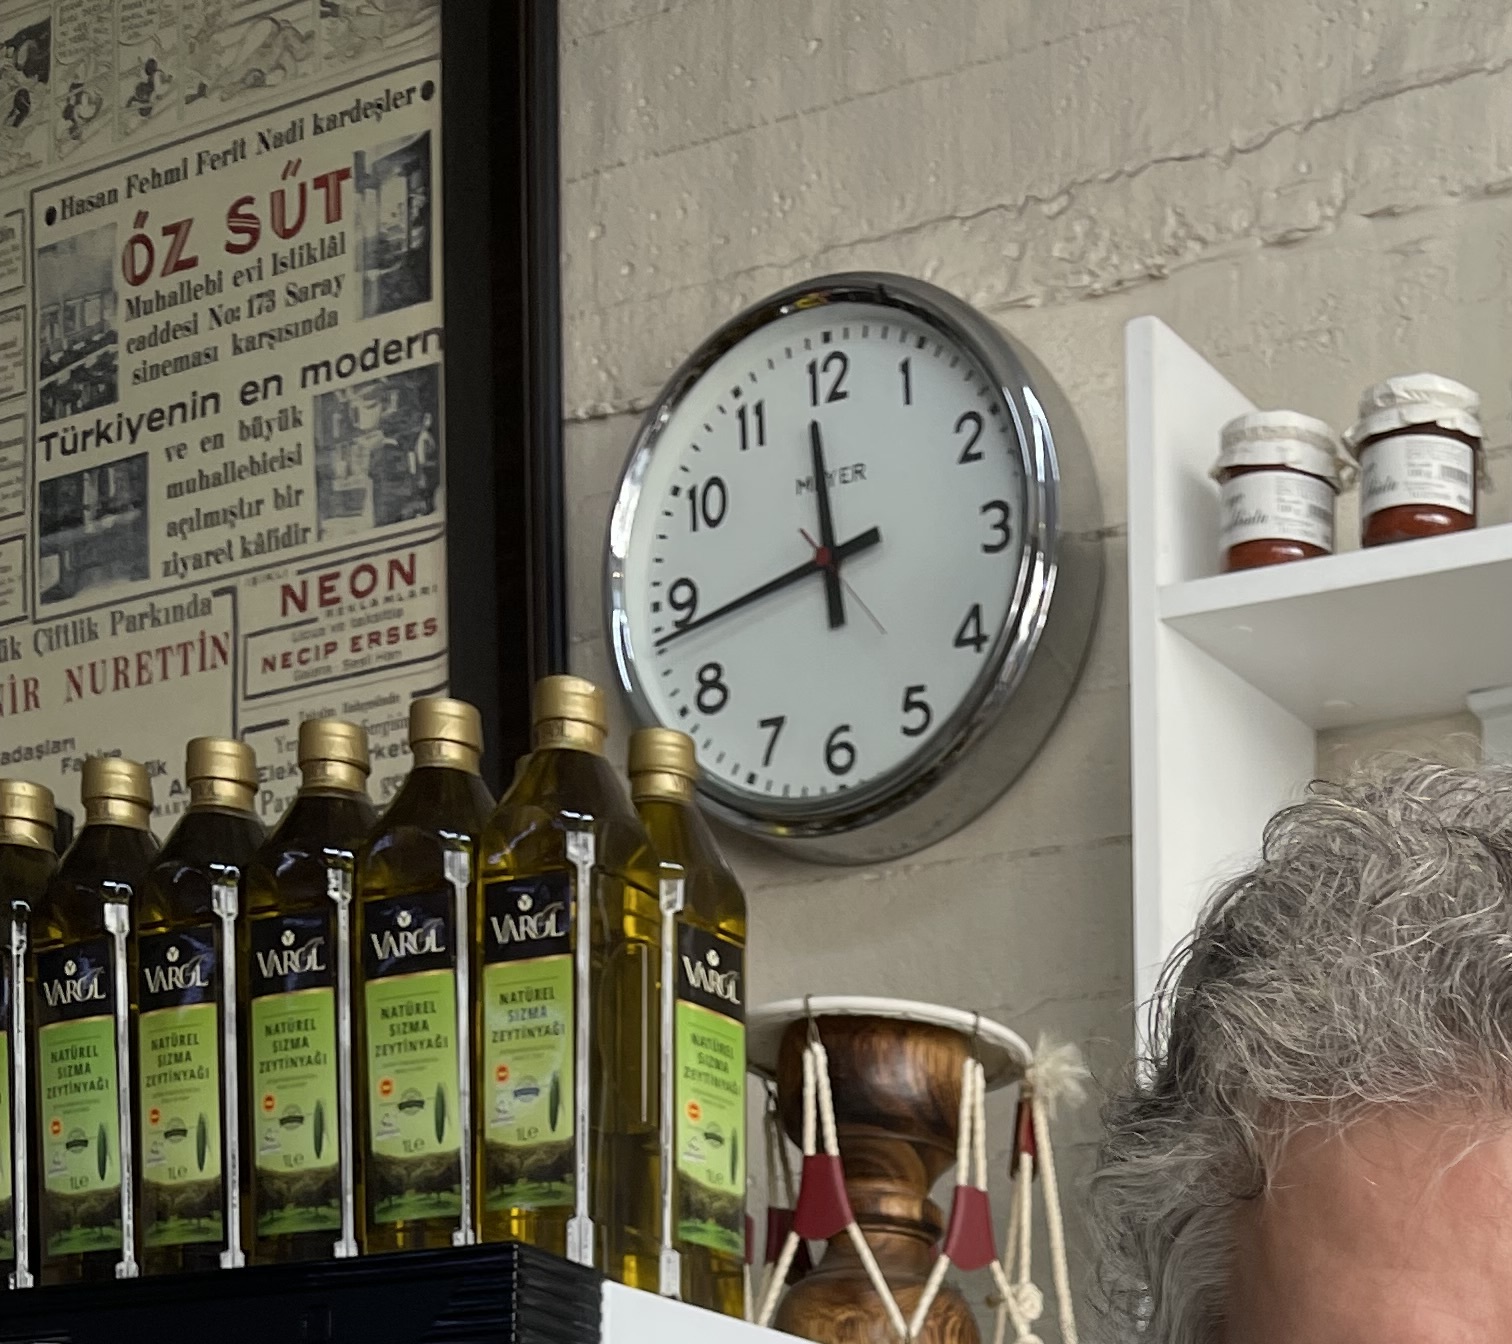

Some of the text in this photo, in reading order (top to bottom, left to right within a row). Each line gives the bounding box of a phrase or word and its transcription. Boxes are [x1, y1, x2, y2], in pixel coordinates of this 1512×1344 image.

[124, 269, 223, 322] Muhallebi
[232, 257, 263, 288] evi
[126, 312, 199, 354] caddesi
[284, 273, 346, 308] Saray
[131, 307, 339, 385] sineması karşısında
[39, 327, 445, 462] Türkiyenin en modern
[807, 351, 852, 407] 12
[899, 357, 914, 405] 1
[238, 405, 303, 442] büyük
[735, 399, 767, 451] 11
[953, 411, 985, 464] 2
[688, 475, 728, 532] 10
[795, 462, 868, 496] MYER
[979, 500, 1011, 554] 3
[280, 552, 417, 618] NEON
[668, 577, 699, 631] 9
[33, 616, 99, 657] Çiftlik
[110, 593, 213, 637] Parkında
[350, 617, 439, 654] ERSES
[953, 603, 990, 654] 4
[64, 630, 230, 704] NURETTİN
[696, 662, 729, 715] 8
[901, 685, 932, 737] 5
[758, 715, 787, 767] 7
[825, 724, 857, 776] 6
[370, 917, 446, 960] VAROL
[490, 901, 566, 945] VAROL
[144, 953, 209, 993] VAROL
[256, 936, 326, 978] VAROL
[43, 967, 106, 1006] VAROL
